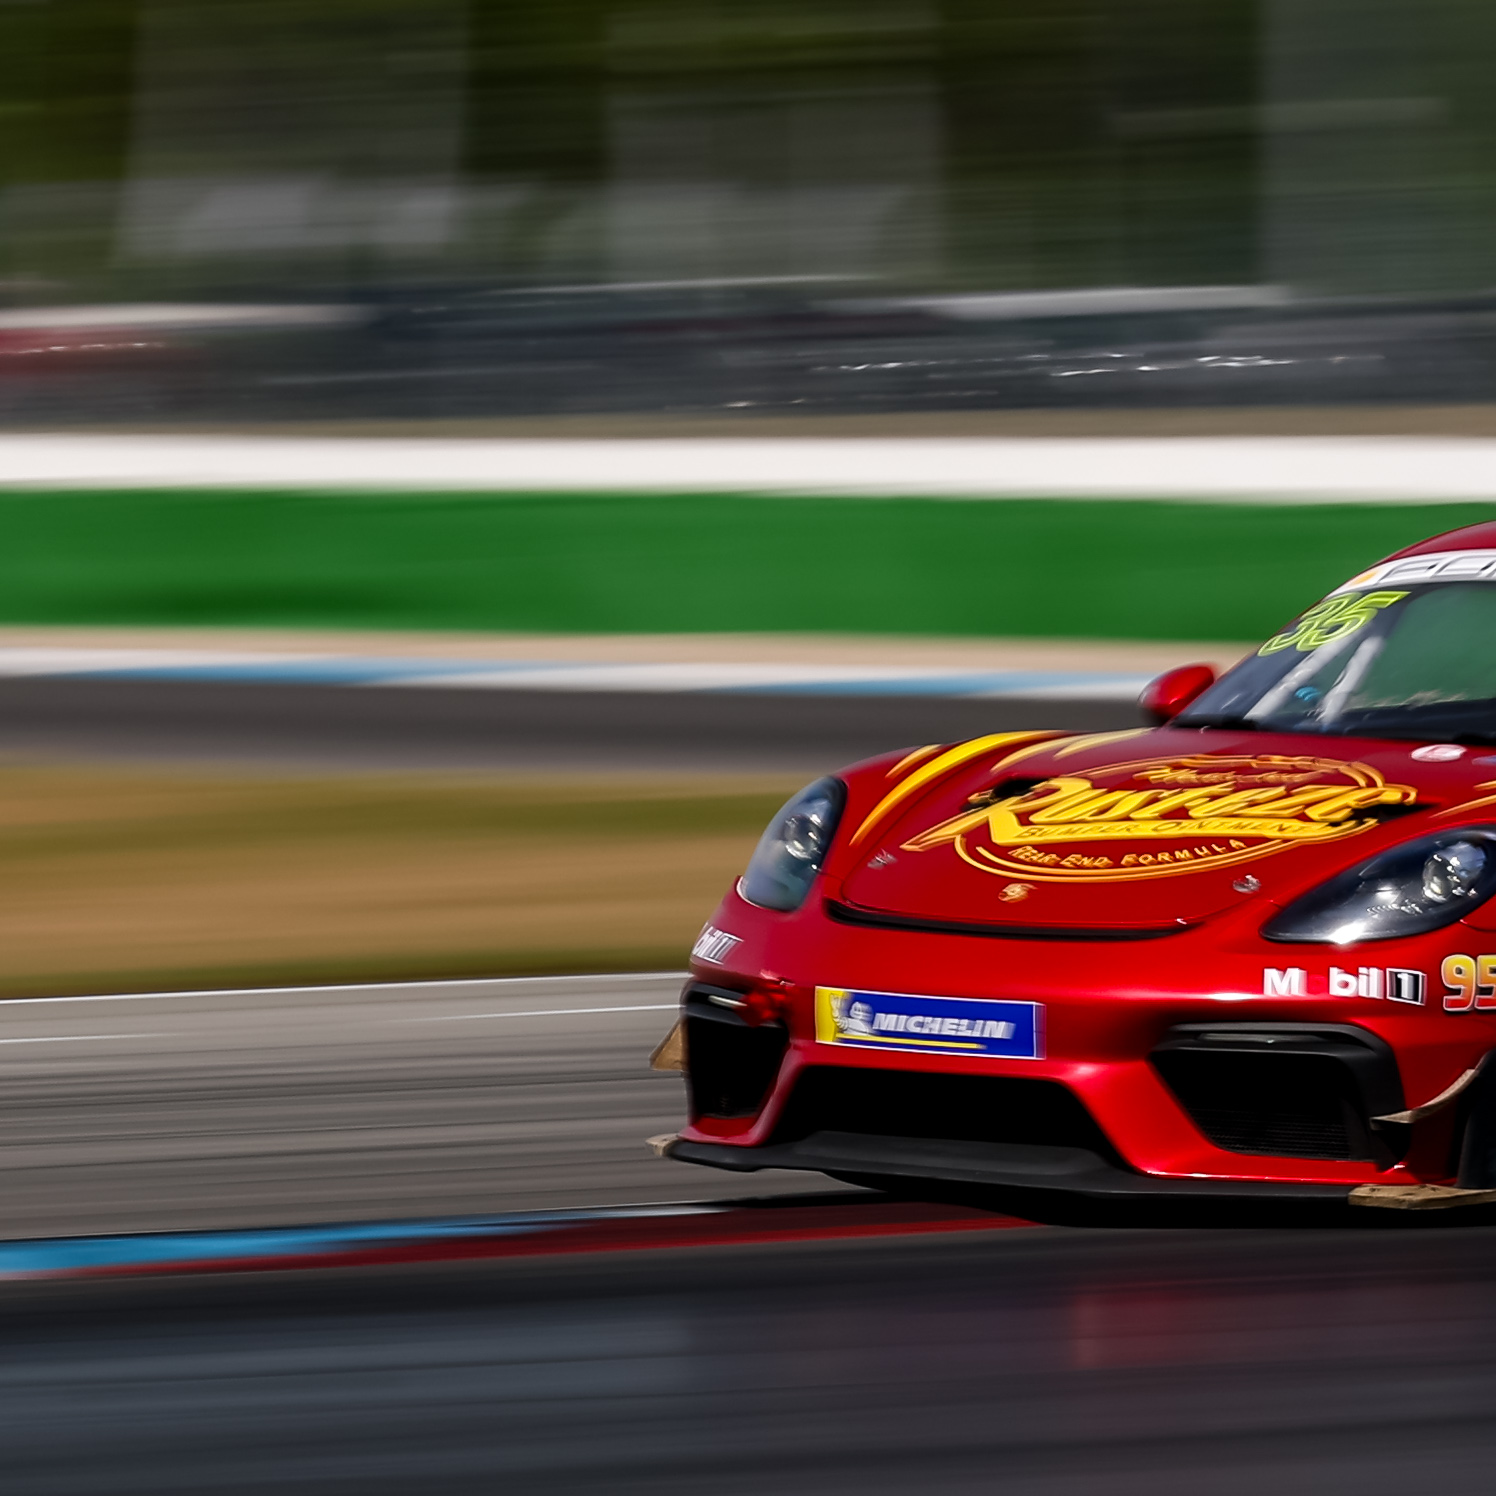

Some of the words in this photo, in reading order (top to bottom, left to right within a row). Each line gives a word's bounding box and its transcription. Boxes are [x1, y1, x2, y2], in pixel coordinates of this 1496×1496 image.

[1257, 591, 1412, 656] 35
[1120, 839, 1248, 866] FORMULA
[1263, 966, 1385, 1000] Mbil
[872, 1013, 1016, 1040] MICHELIN
